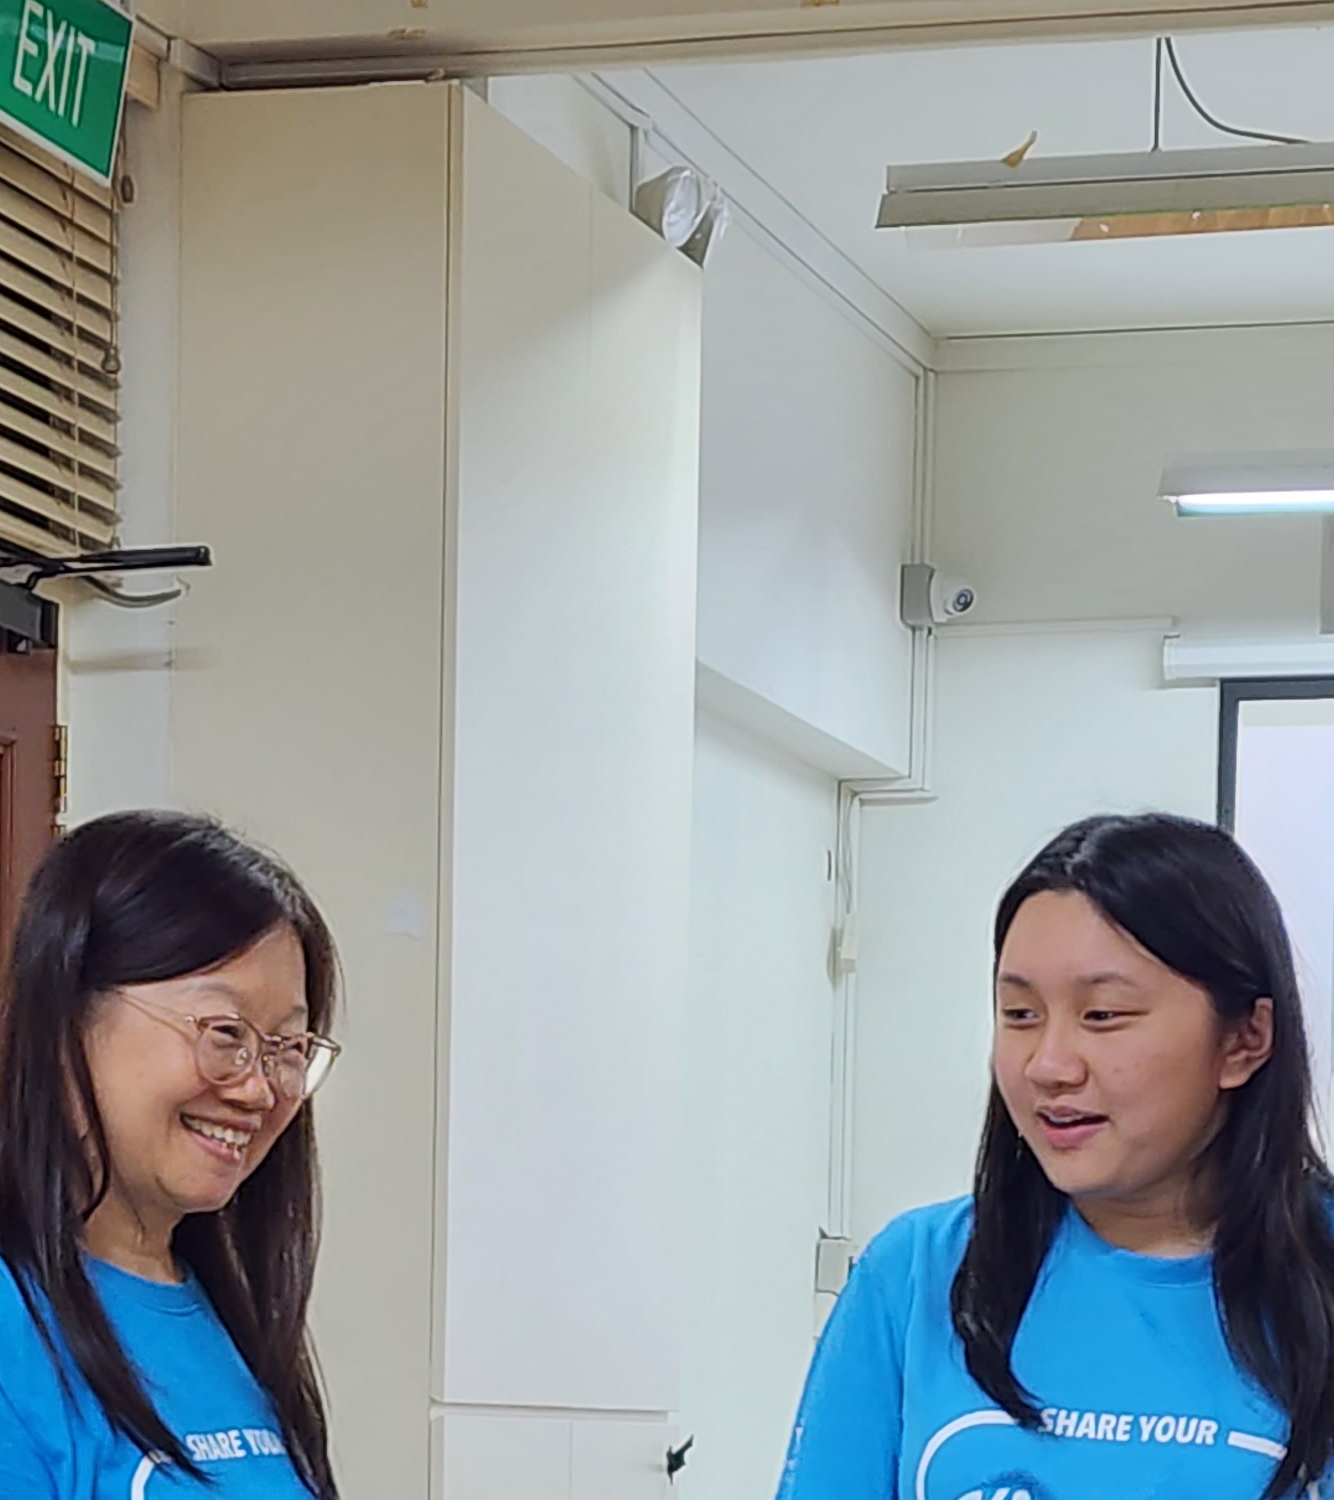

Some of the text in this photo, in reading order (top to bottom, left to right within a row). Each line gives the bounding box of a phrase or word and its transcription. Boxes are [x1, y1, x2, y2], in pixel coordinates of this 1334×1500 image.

[13, 0, 95, 127] EXIT
[186, 1428, 247, 1461] SHARE
[1037, 1407, 1219, 1445] SHARE YOUR
